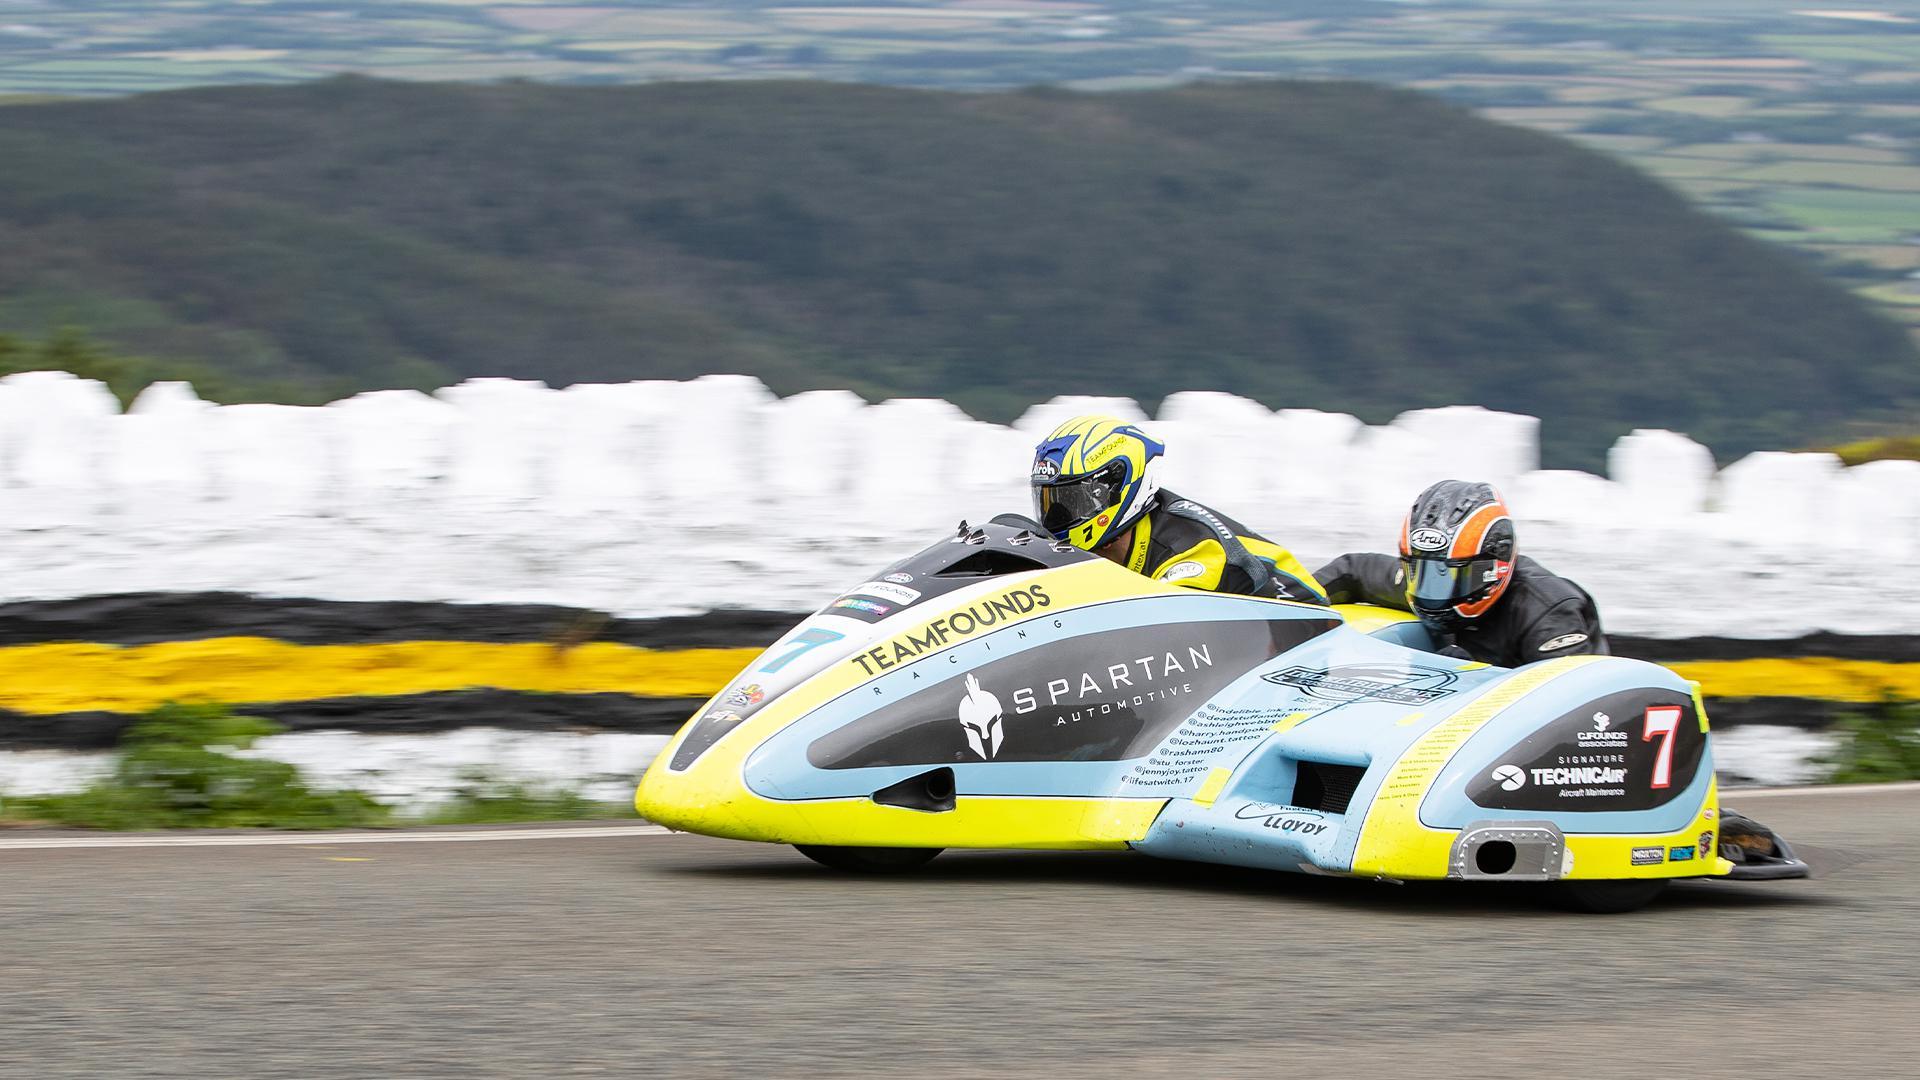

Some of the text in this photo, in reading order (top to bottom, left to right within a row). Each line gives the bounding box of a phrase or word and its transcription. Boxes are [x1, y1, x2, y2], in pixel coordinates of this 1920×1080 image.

[1083, 524, 1093, 543] 7
[1411, 533, 1444, 546] Arai
[851, 584, 1051, 676] TEAMFOUNDS
[758, 628, 846, 674] 7
[873, 619, 1062, 695] RACING
[1013, 644, 1213, 715] SPARTAN
[1056, 683, 1193, 726] AUTOMOTIVE
[1160, 746, 1224, 757] @rashann80
[1642, 705, 1682, 789] 7
[1558, 754, 1625, 764] SIGNATURE
[1135, 765, 1209, 776] @jennyjoy.tattoo
[1559, 787, 1625, 798] Aircraft Maintenance
[1263, 816, 1328, 836] LLOYDY
